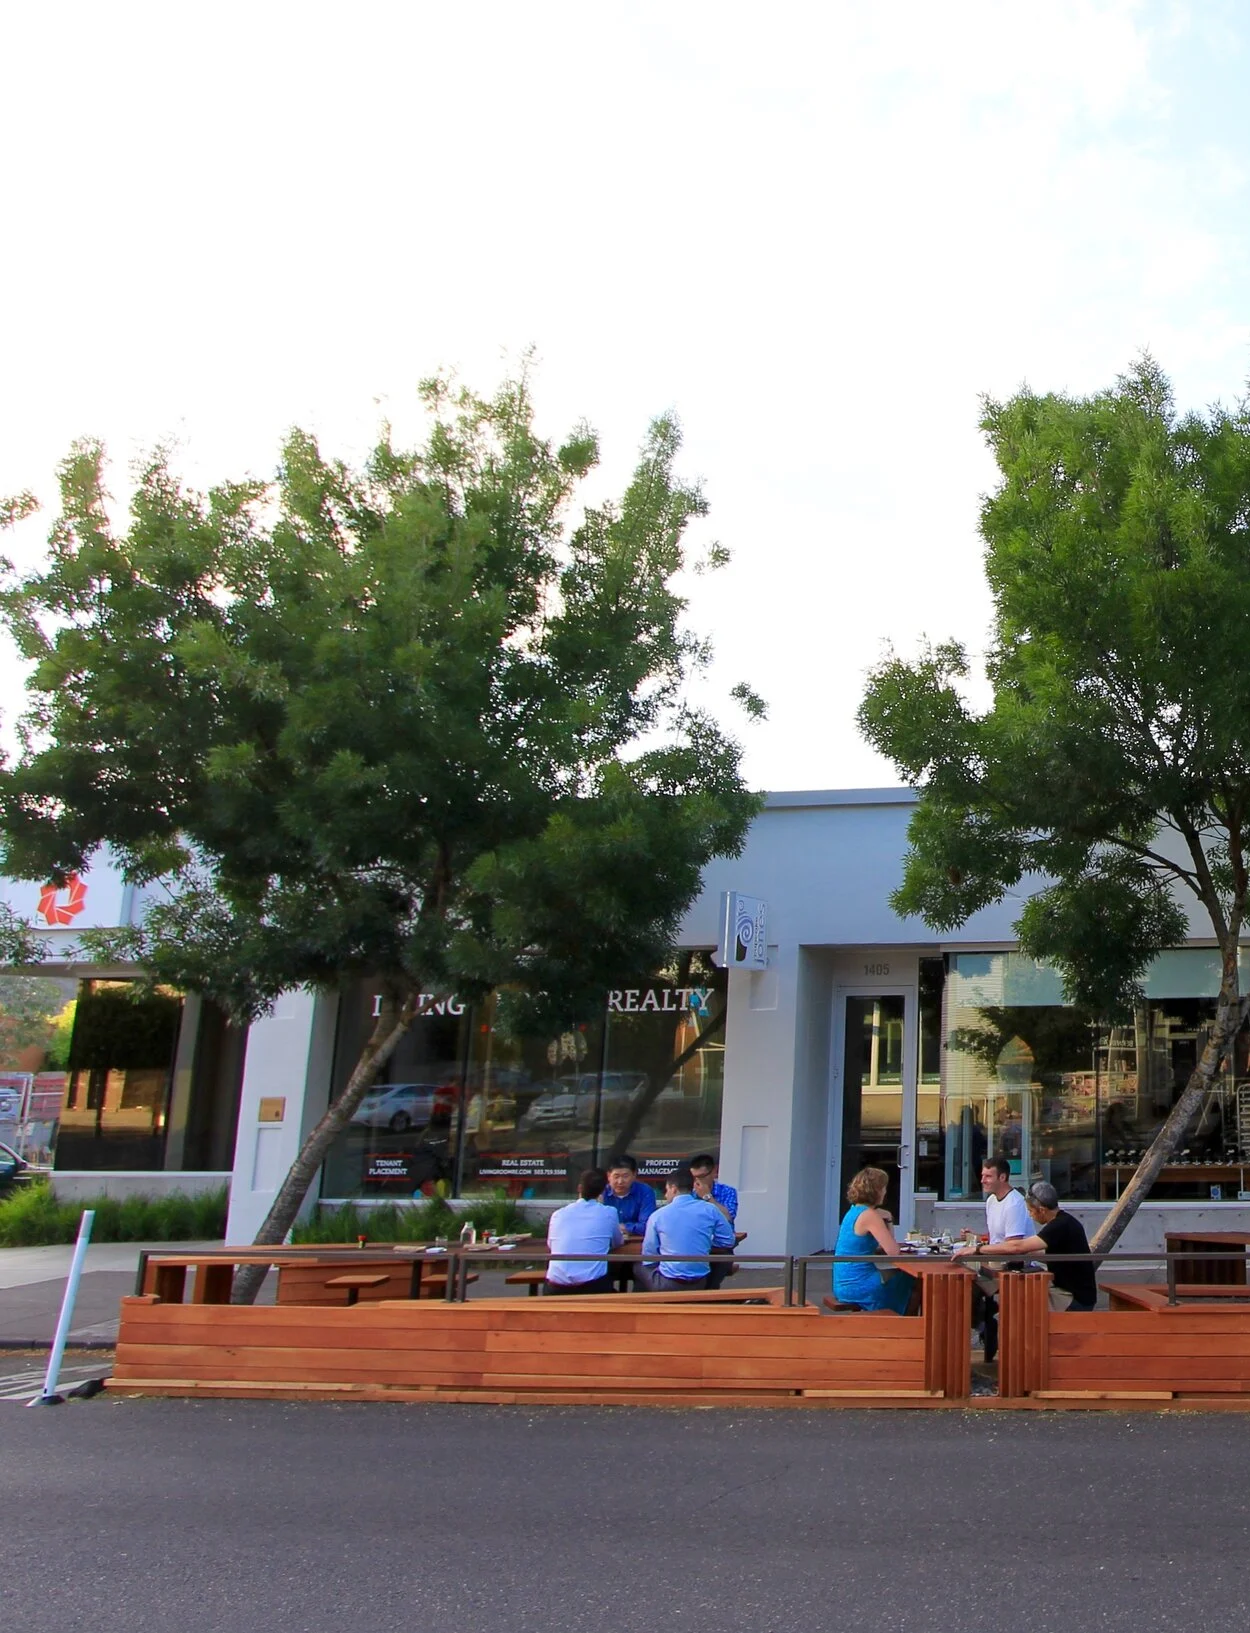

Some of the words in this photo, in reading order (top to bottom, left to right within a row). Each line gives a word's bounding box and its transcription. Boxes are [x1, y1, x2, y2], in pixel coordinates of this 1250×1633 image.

[863, 962, 890, 976] 1405
[372, 993, 466, 1016] LING
[608, 988, 715, 1012] REALTY
[375, 1159, 403, 1167] TENANT
[501, 1159, 519, 1167] REAL
[519, 1159, 545, 1167] ESTATE
[645, 1159, 680, 1167] PROPERTY
[368, 1167, 408, 1176] PLACEMENT
